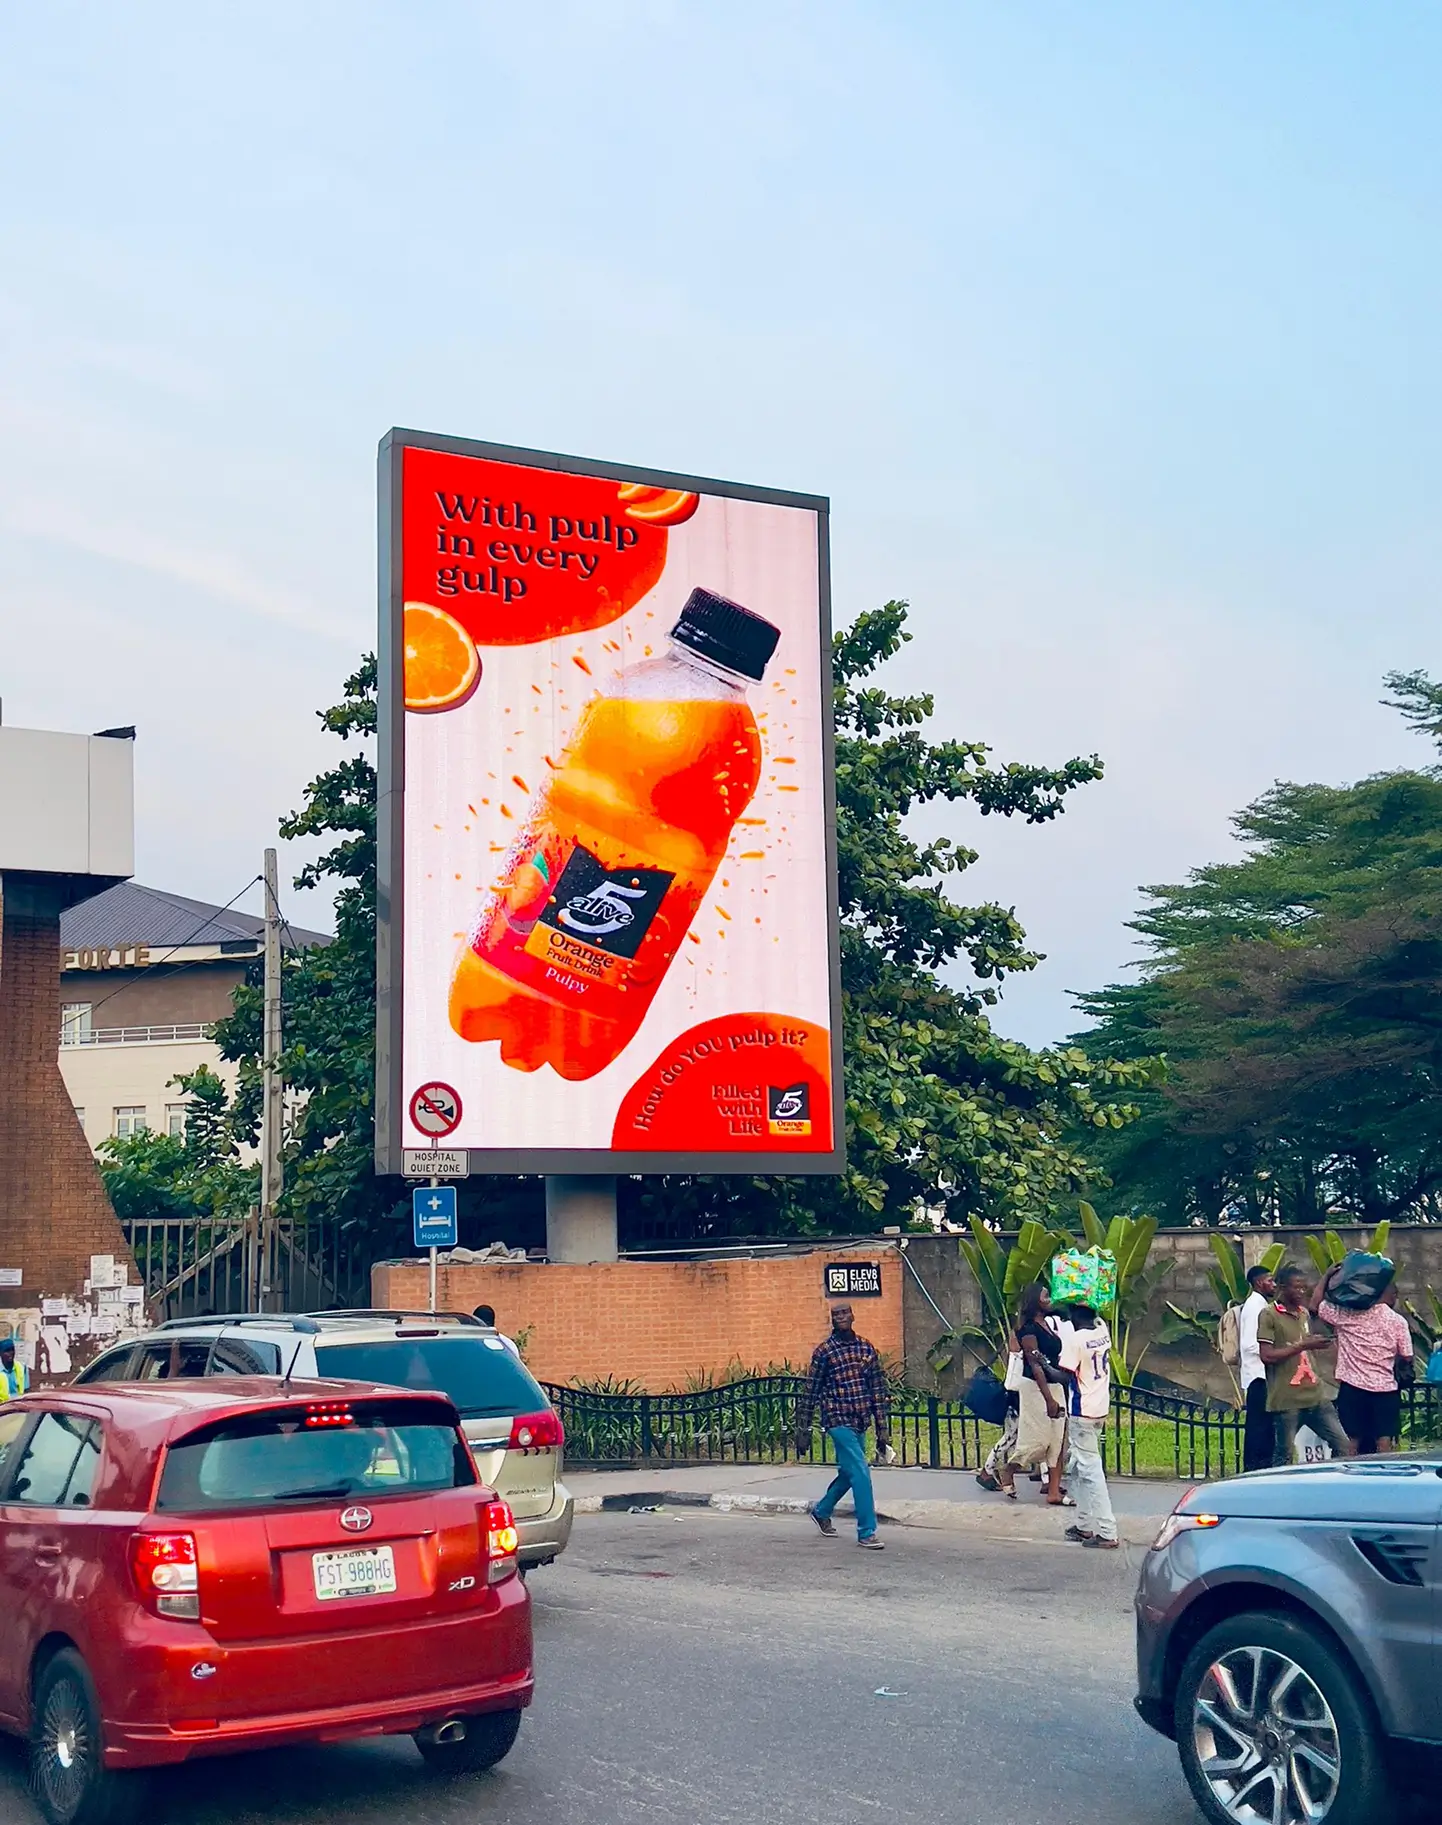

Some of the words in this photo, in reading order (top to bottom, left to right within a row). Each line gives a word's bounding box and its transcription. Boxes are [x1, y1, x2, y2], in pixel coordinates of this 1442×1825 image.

[434, 491, 537, 534] With
[549, 515, 639, 552] pulp
[436, 525, 476, 558] in
[487, 539, 599, 581] every
[436, 566, 527, 604] gulp
[566, 896, 635, 925] alive
[60, 941, 151, 972] FORTE
[546, 947, 573, 967] Fruit
[573, 959, 604, 978] Drink
[550, 931, 615, 969] Orange
[545, 967, 590, 993] Pulpy
[632, 1086, 664, 1131] How
[660, 1064, 685, 1086] do
[680, 1036, 724, 1065] YOU
[728, 1028, 777, 1052] pulp
[781, 1027, 809, 1047] it?
[711, 1084, 763, 1101] Filled
[717, 1101, 763, 1118] with
[729, 1120, 763, 1136] Life
[410, 1163, 436, 1173] QUIET
[437, 1163, 461, 1173] ZONE
[414, 1152, 457, 1162] HOSPITAL
[849, 1268, 878, 1280] ELEV8
[850, 1280, 880, 1292] MEDIA
[448, 1576, 476, 1592] xD
